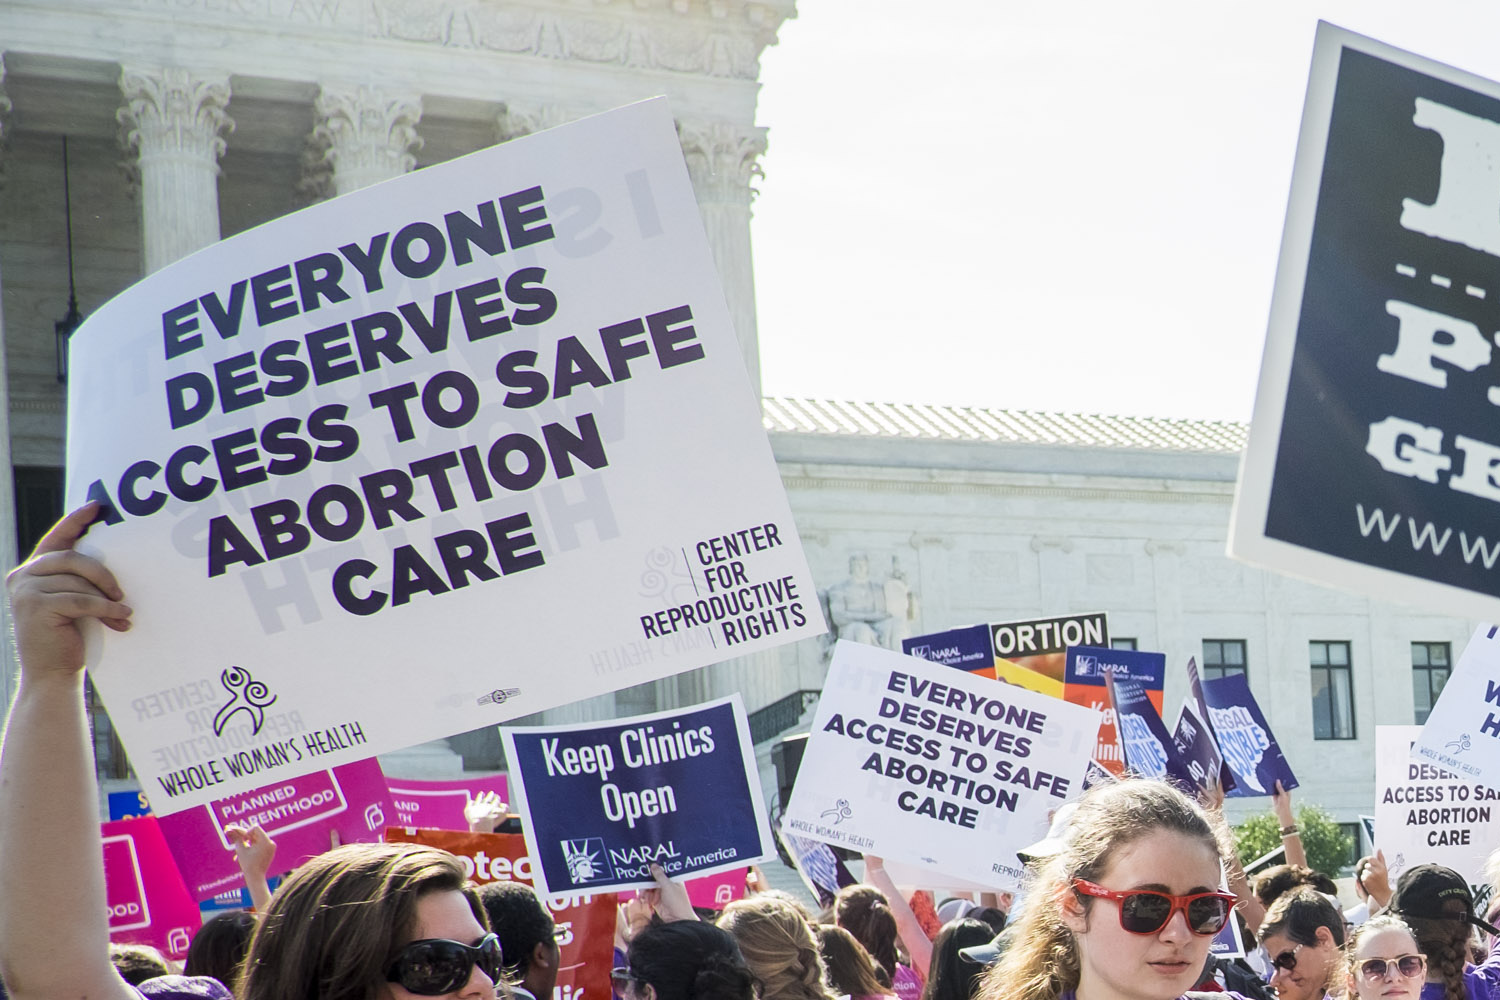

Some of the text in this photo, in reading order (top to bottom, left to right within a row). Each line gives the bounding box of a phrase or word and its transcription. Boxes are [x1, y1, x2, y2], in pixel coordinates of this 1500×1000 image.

[163, 185, 555, 360] EVERYONE
[166, 267, 558, 430] DESERVES
[86, 304, 705, 528] ACCESS TO SAFE
[207, 412, 609, 578] ABORTION
[332, 511, 545, 617] CARE
[696, 522, 783, 566] CENTER
[704, 561, 749, 593] FOR
[640, 575, 799, 640] REPRODUCTIVE
[721, 602, 807, 646] RIGHTS
[931, 646, 960, 659] NARAL
[994, 617, 1104, 655] ORTION
[887, 671, 1047, 734] EVERYONE
[878, 697, 1032, 758] DESERVES
[157, 721, 368, 798] WHOLE WOMAN'S HEALTH
[540, 722, 715, 781] Keep Clinics
[823, 713, 1070, 799] ACCESS TO SAFE
[222, 784, 296, 818] PLANNED
[861, 752, 1019, 812] ABORTION
[1383, 787, 1444, 804] ACCESS
[1448, 786, 1470, 801] TO
[600, 783, 677, 828] Open
[898, 791, 979, 829] CARE
[1406, 806, 1491, 826] ABORTION
[609, 841, 681, 867] NARAL
[790, 818, 875, 849] WHOLE WOMAN'S HEALTH
[1427, 829, 1471, 847] CARE
[615, 847, 738, 880] Pro-Cice America
